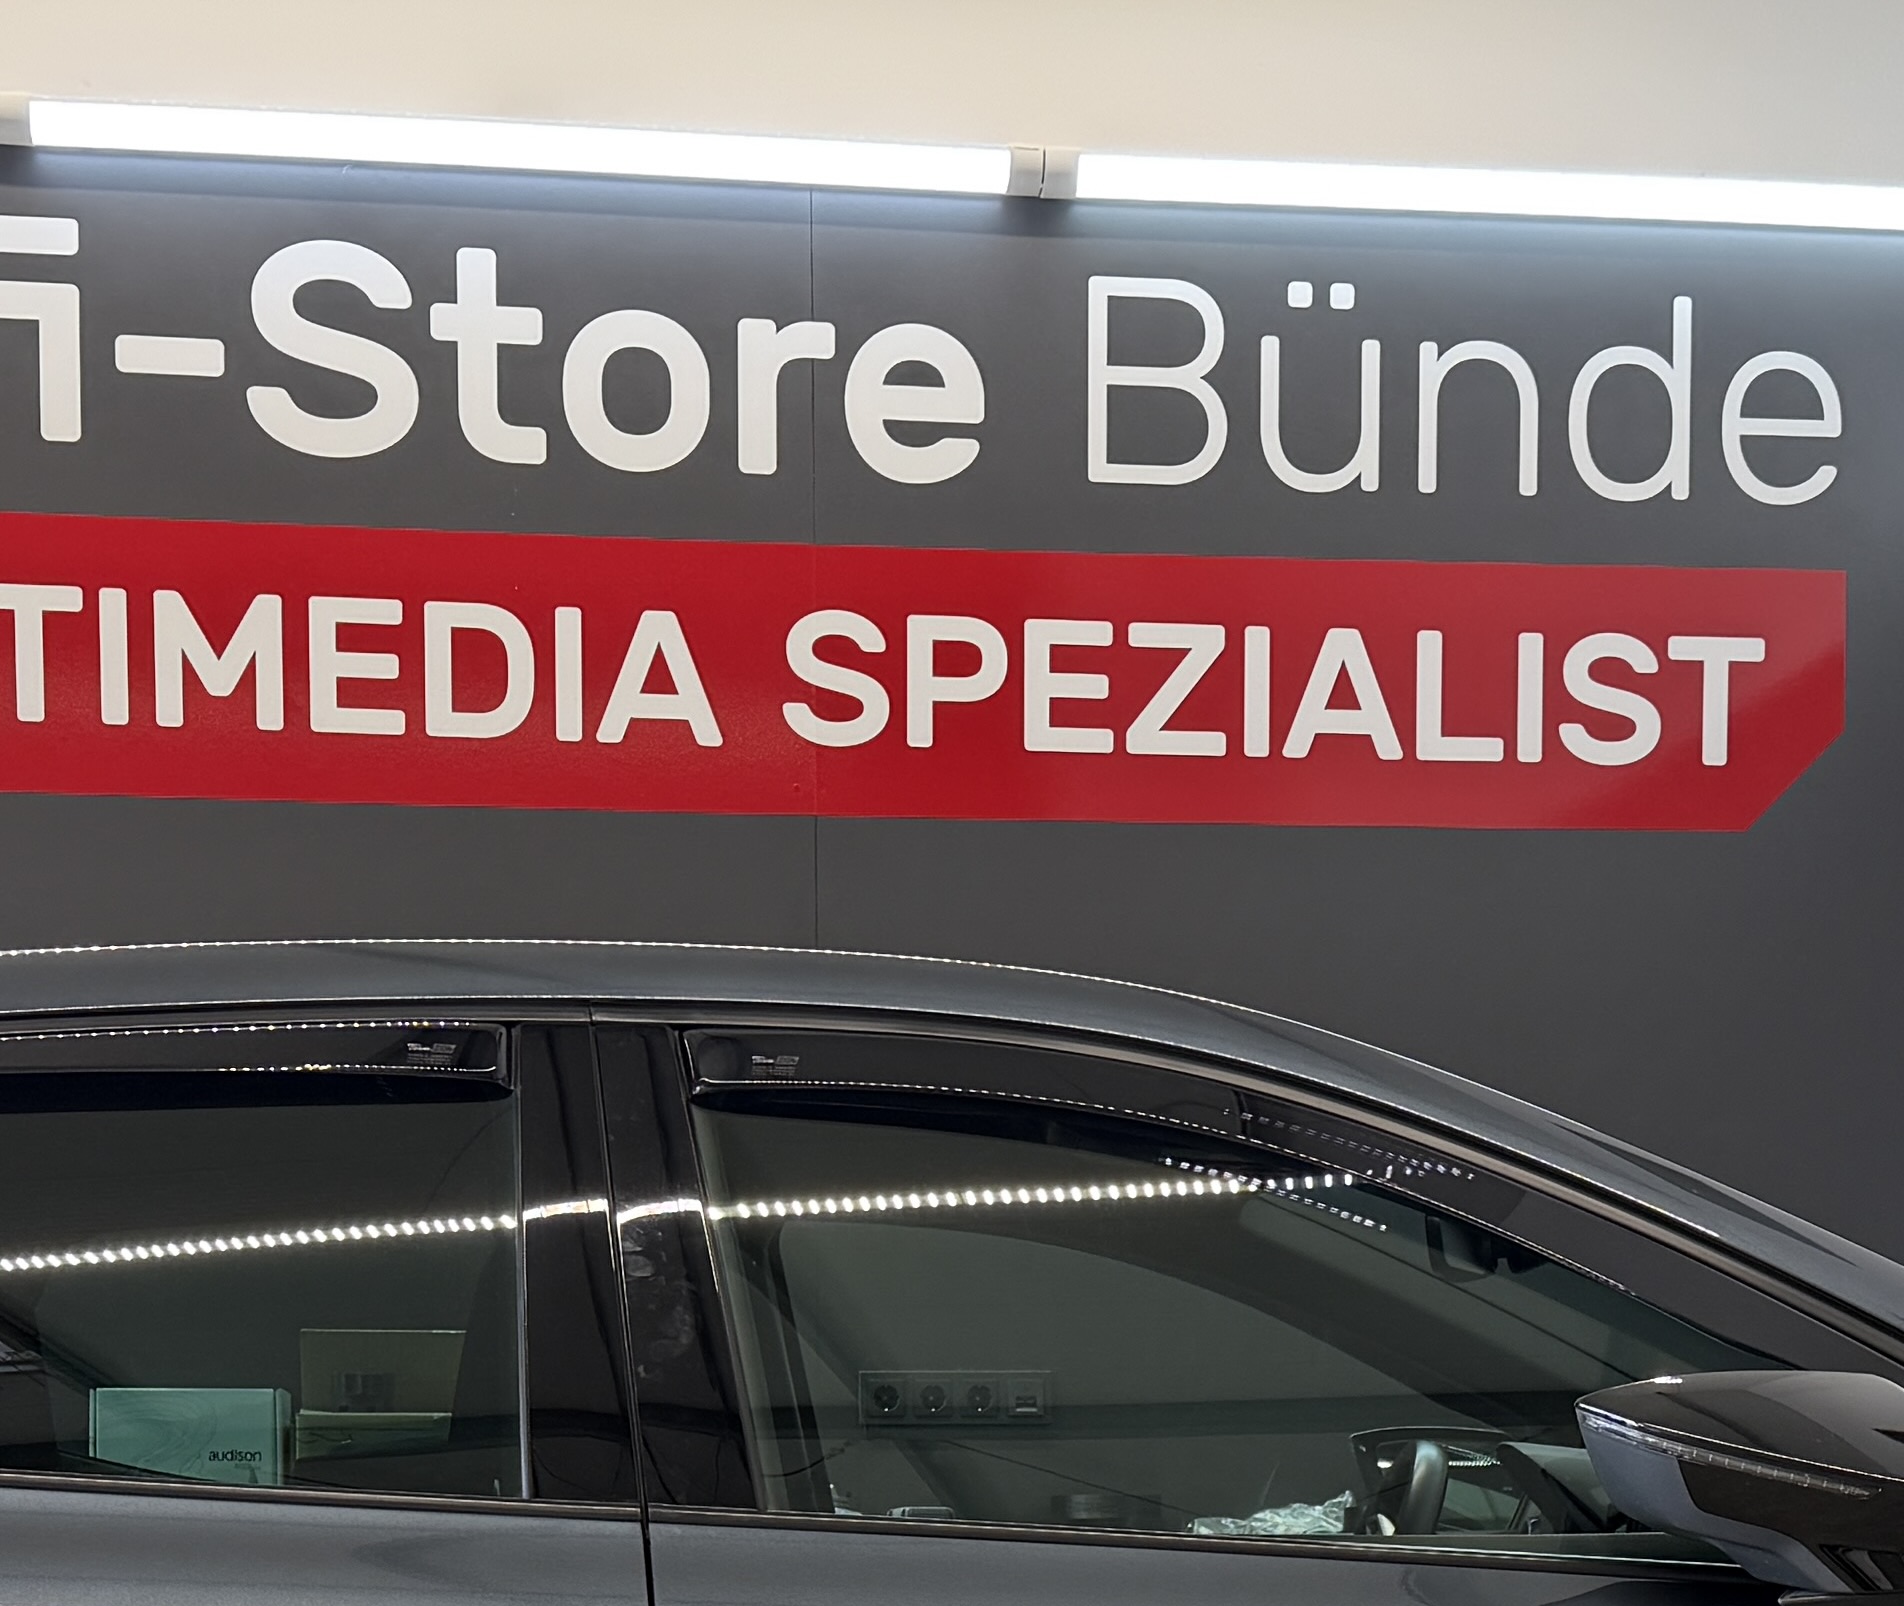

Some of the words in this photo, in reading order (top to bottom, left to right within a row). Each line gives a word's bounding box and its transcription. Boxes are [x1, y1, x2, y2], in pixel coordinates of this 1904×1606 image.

[1088, 276, 1841, 505] Bünde
[783, 610, 1765, 766] SPEZIALIST
[208, 1449, 262, 1462] audison
